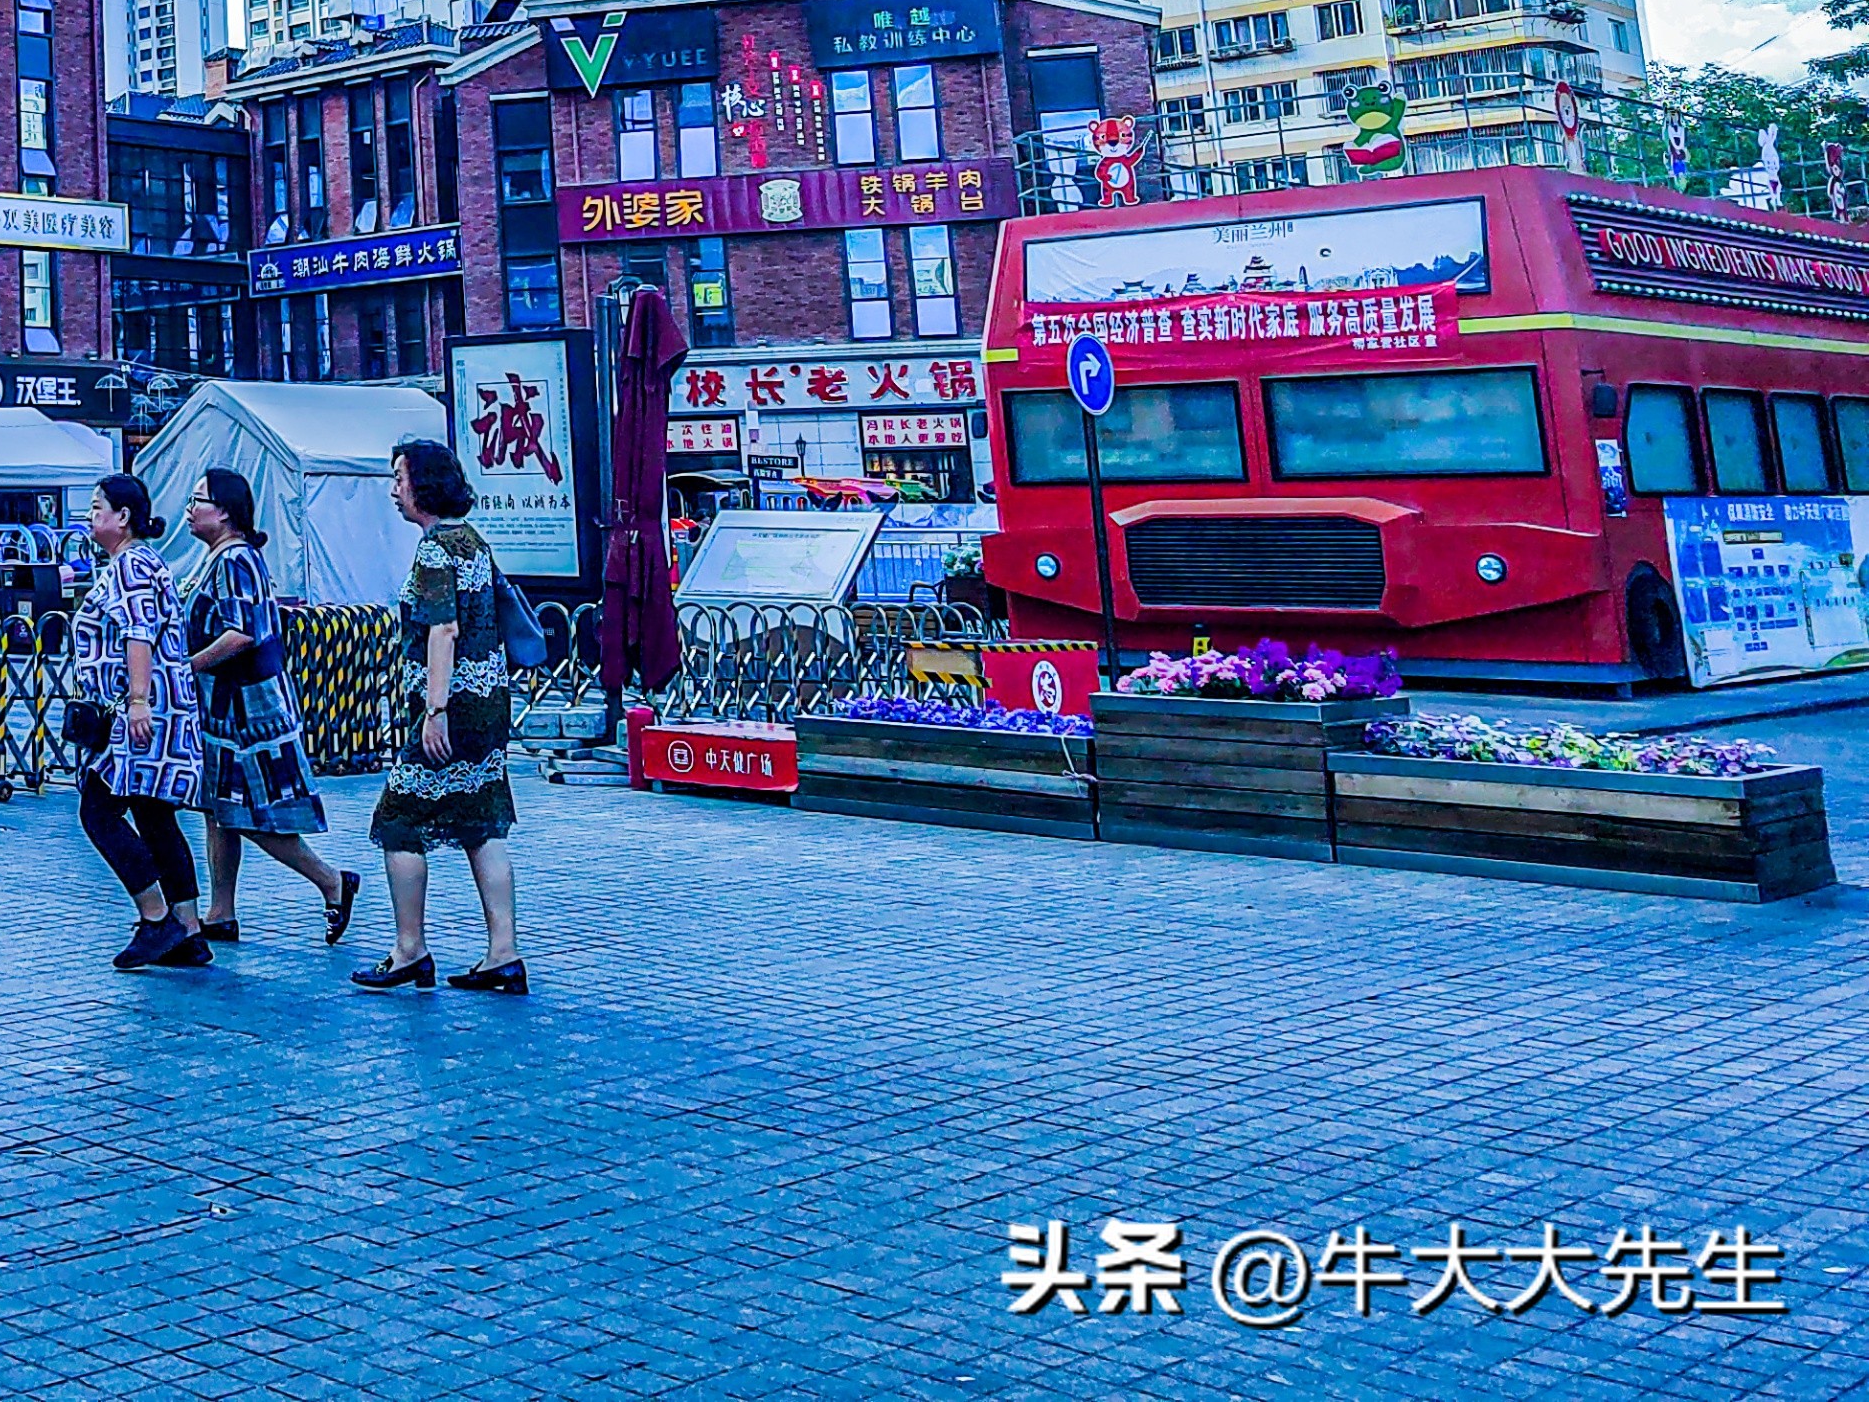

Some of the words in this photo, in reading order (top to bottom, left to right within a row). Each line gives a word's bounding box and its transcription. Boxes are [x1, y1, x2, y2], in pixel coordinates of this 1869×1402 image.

[833, 26, 976, 54] 私教训练中心
[860, 169, 981, 195] 铁锅羊肉
[583, 189, 704, 231] 外婆家
[862, 192, 984, 216] 大锅台
[1213, 220, 1286, 244] 美丽兰州
[292, 238, 457, 279] 潮汕牛肉海鲜火锅
[1605, 228, 1663, 266] GOOD
[1664, 236, 1776, 281] INGREDIENTS
[1773, 254, 1822, 287] MAKE
[1820, 261, 1862, 294] GOOD
[1031, 307, 1173, 346] 第五次全国经济普查
[1180, 302, 1300, 342] 查实新时代家底
[1306, 294, 1436, 337] 服务高质量发展
[16, 376, 76, 405] 汉堡王
[474, 493, 515, 510] 信经商
[705, 748, 773, 777] 中天健广场
